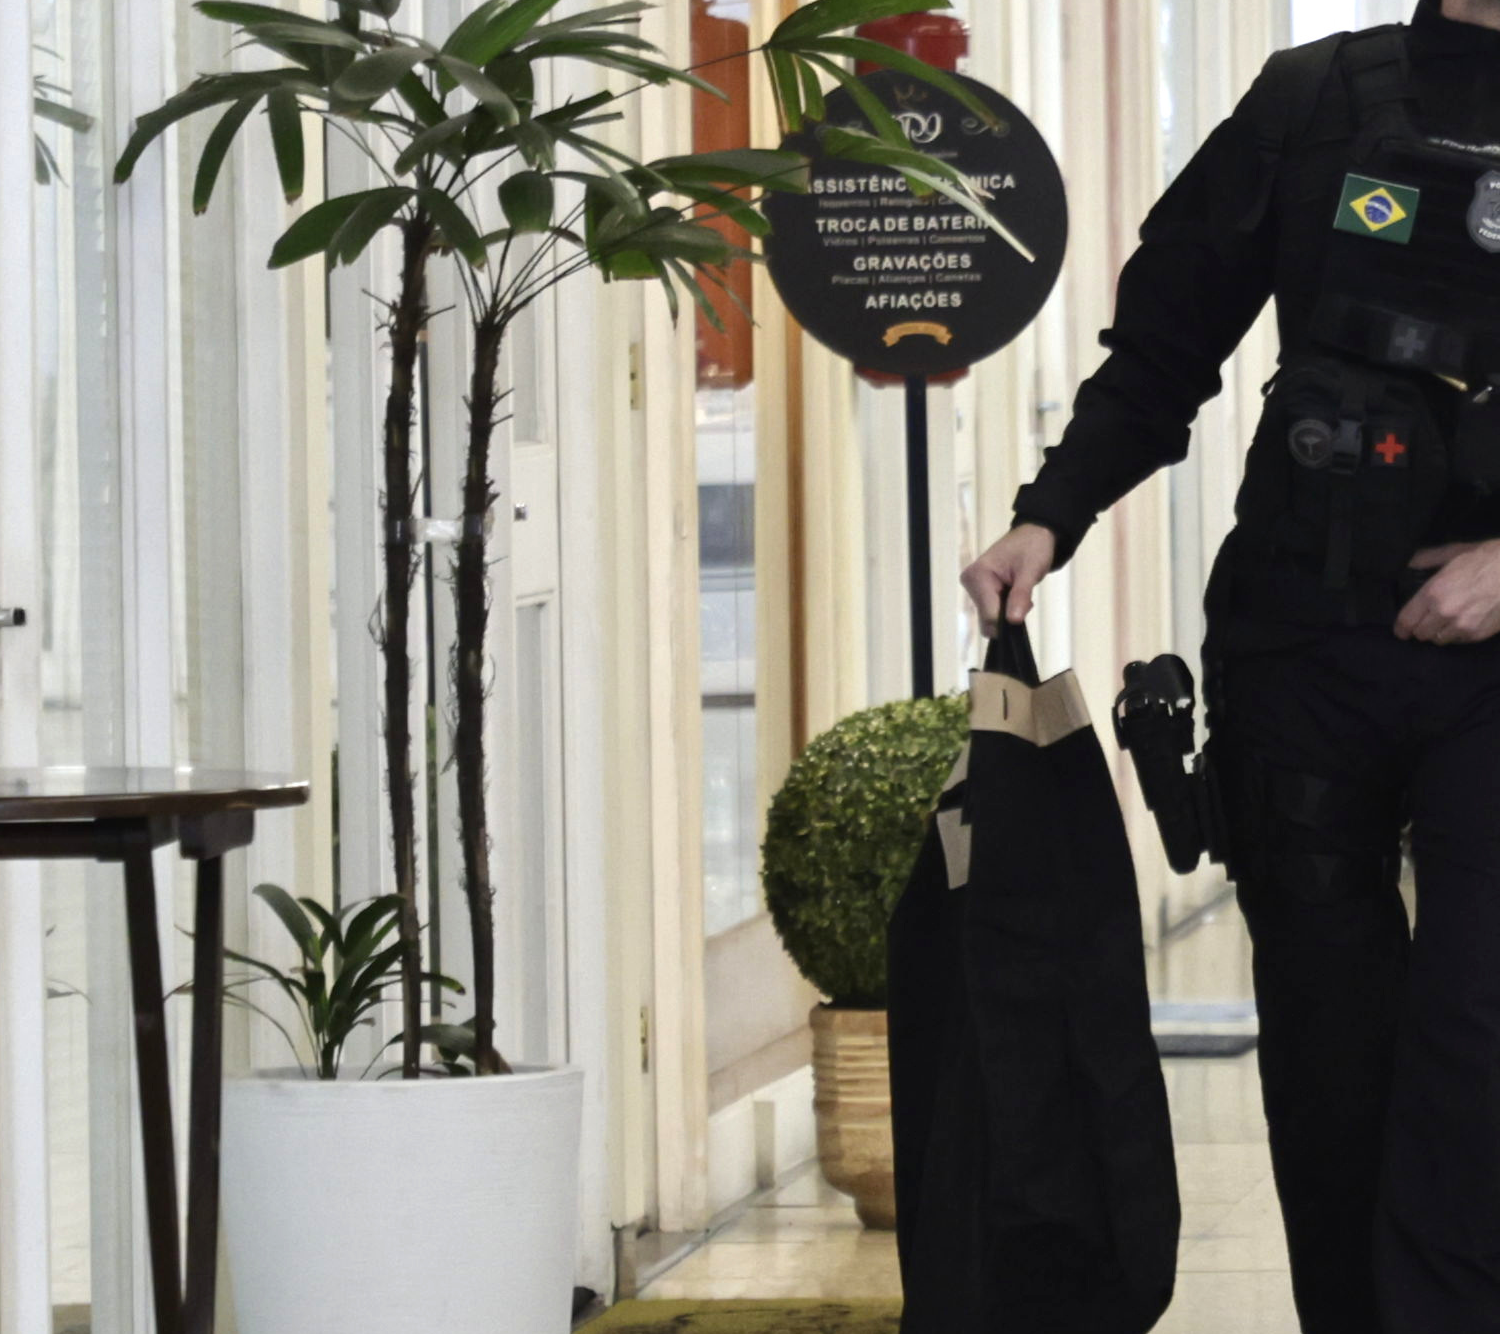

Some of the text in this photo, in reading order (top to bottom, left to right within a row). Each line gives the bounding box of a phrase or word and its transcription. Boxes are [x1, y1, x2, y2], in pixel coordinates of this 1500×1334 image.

[815, 218, 881, 234] TROCA
[884, 217, 909, 232] DE
[853, 252, 972, 273] GRAVAÇÕES
[865, 290, 962, 312] AFIAÇÕES
